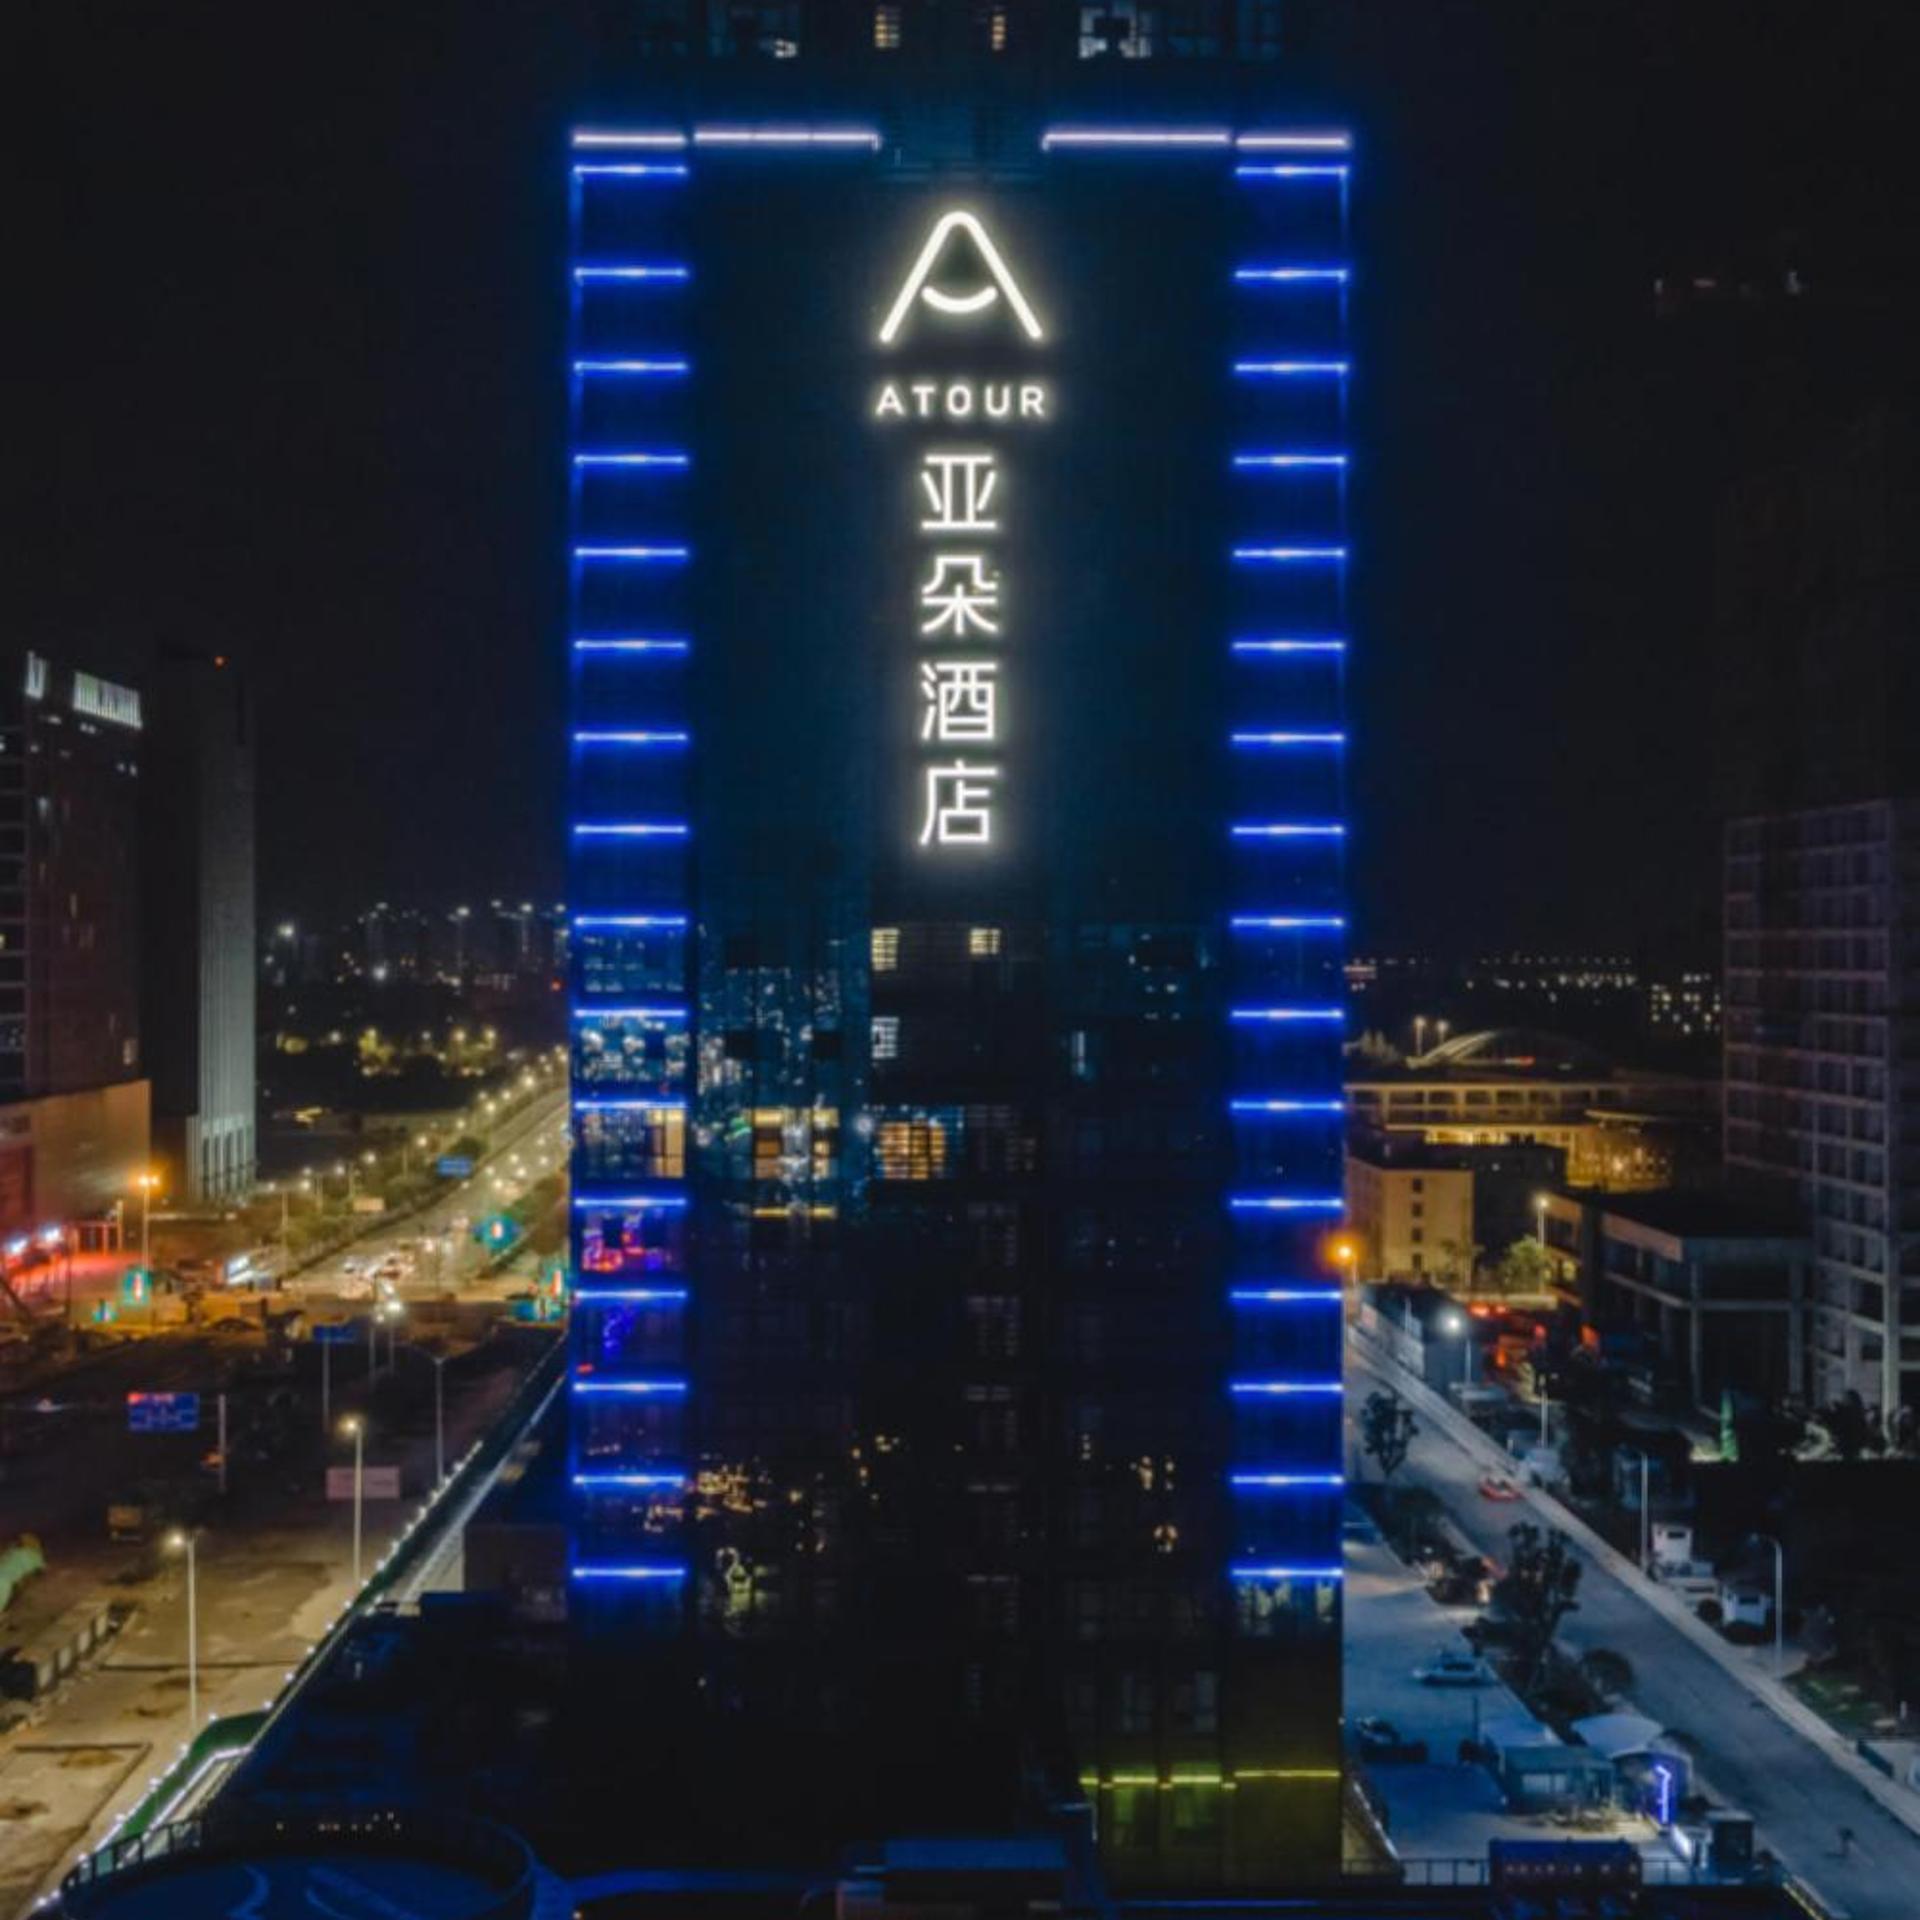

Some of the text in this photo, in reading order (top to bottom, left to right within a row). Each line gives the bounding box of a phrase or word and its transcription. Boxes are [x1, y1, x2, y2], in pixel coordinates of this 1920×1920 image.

[875, 383, 1045, 418] ATOUR
[918, 453, 999, 847] 亚朵酒店
